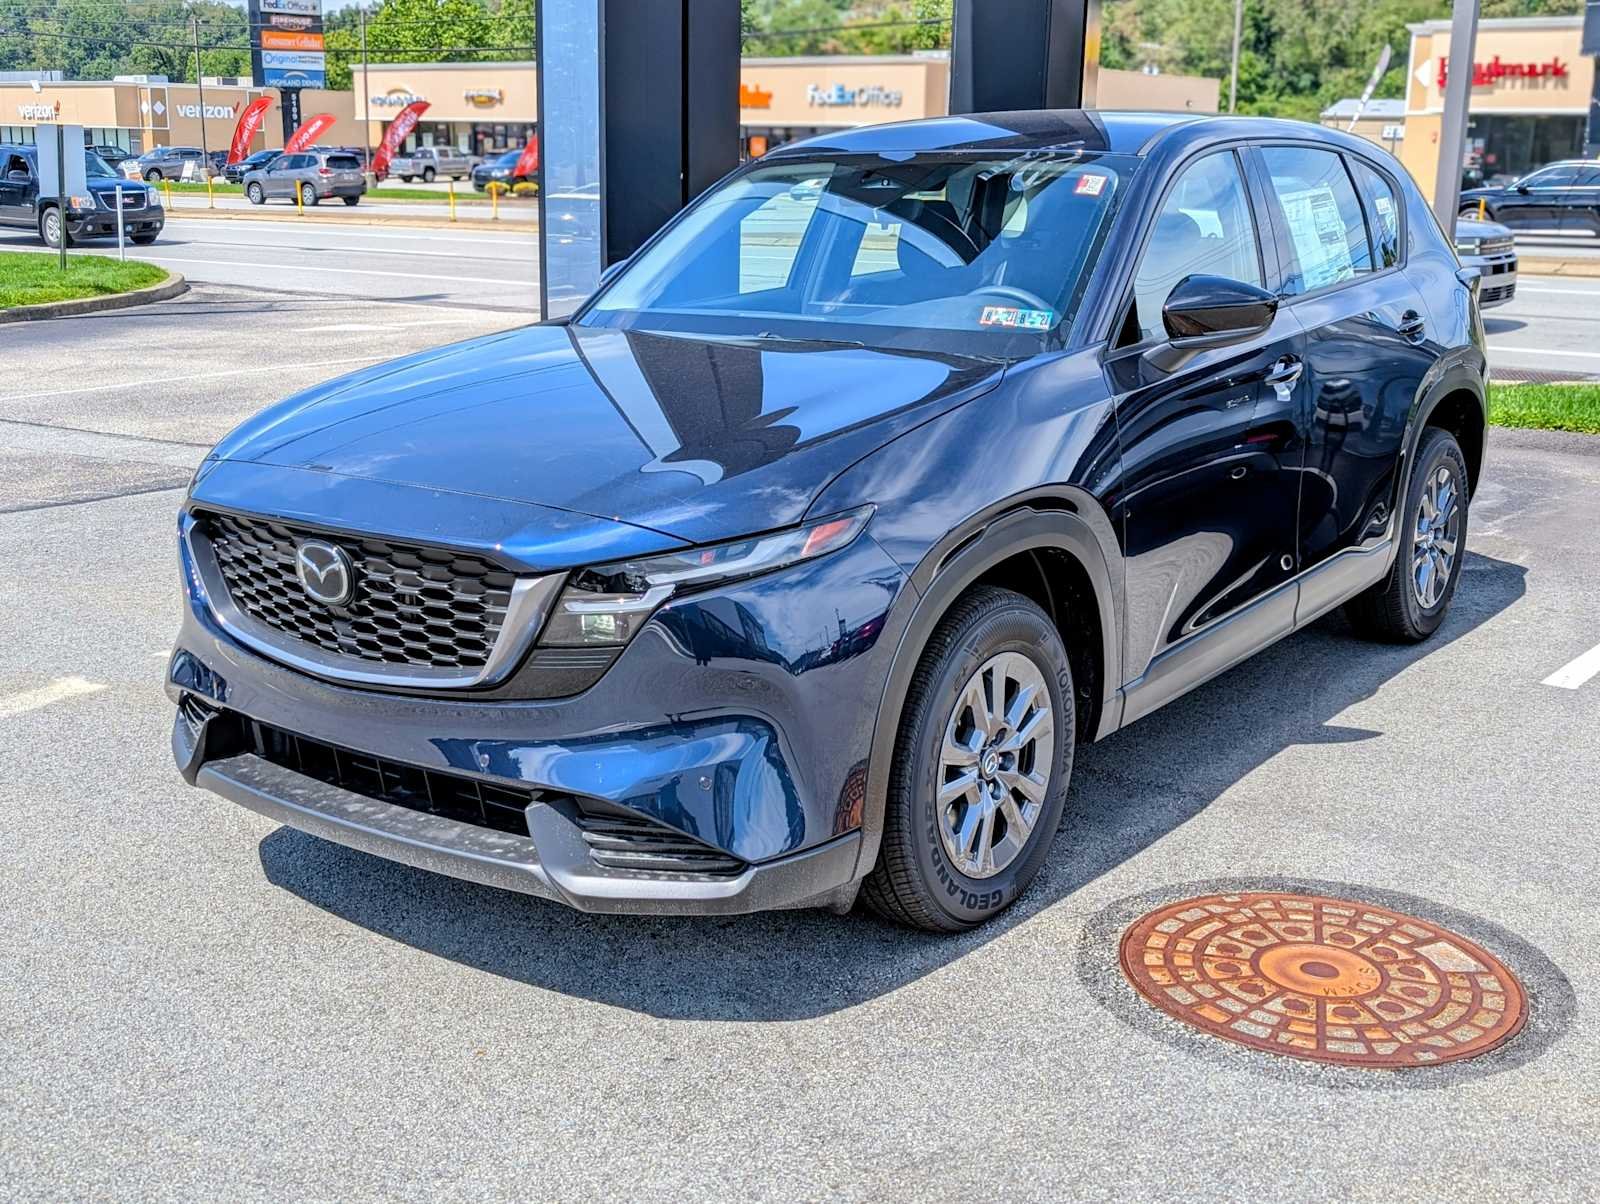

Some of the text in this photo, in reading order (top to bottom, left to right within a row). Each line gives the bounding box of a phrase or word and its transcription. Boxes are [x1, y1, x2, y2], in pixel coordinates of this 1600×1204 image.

[859, 85, 903, 107] Office
[17, 102, 55, 119] verizon
[176, 103, 234, 119] verizon
[1056, 662, 1075, 775] YOKOHAMA
[1322, 968, 1378, 996] STORM
